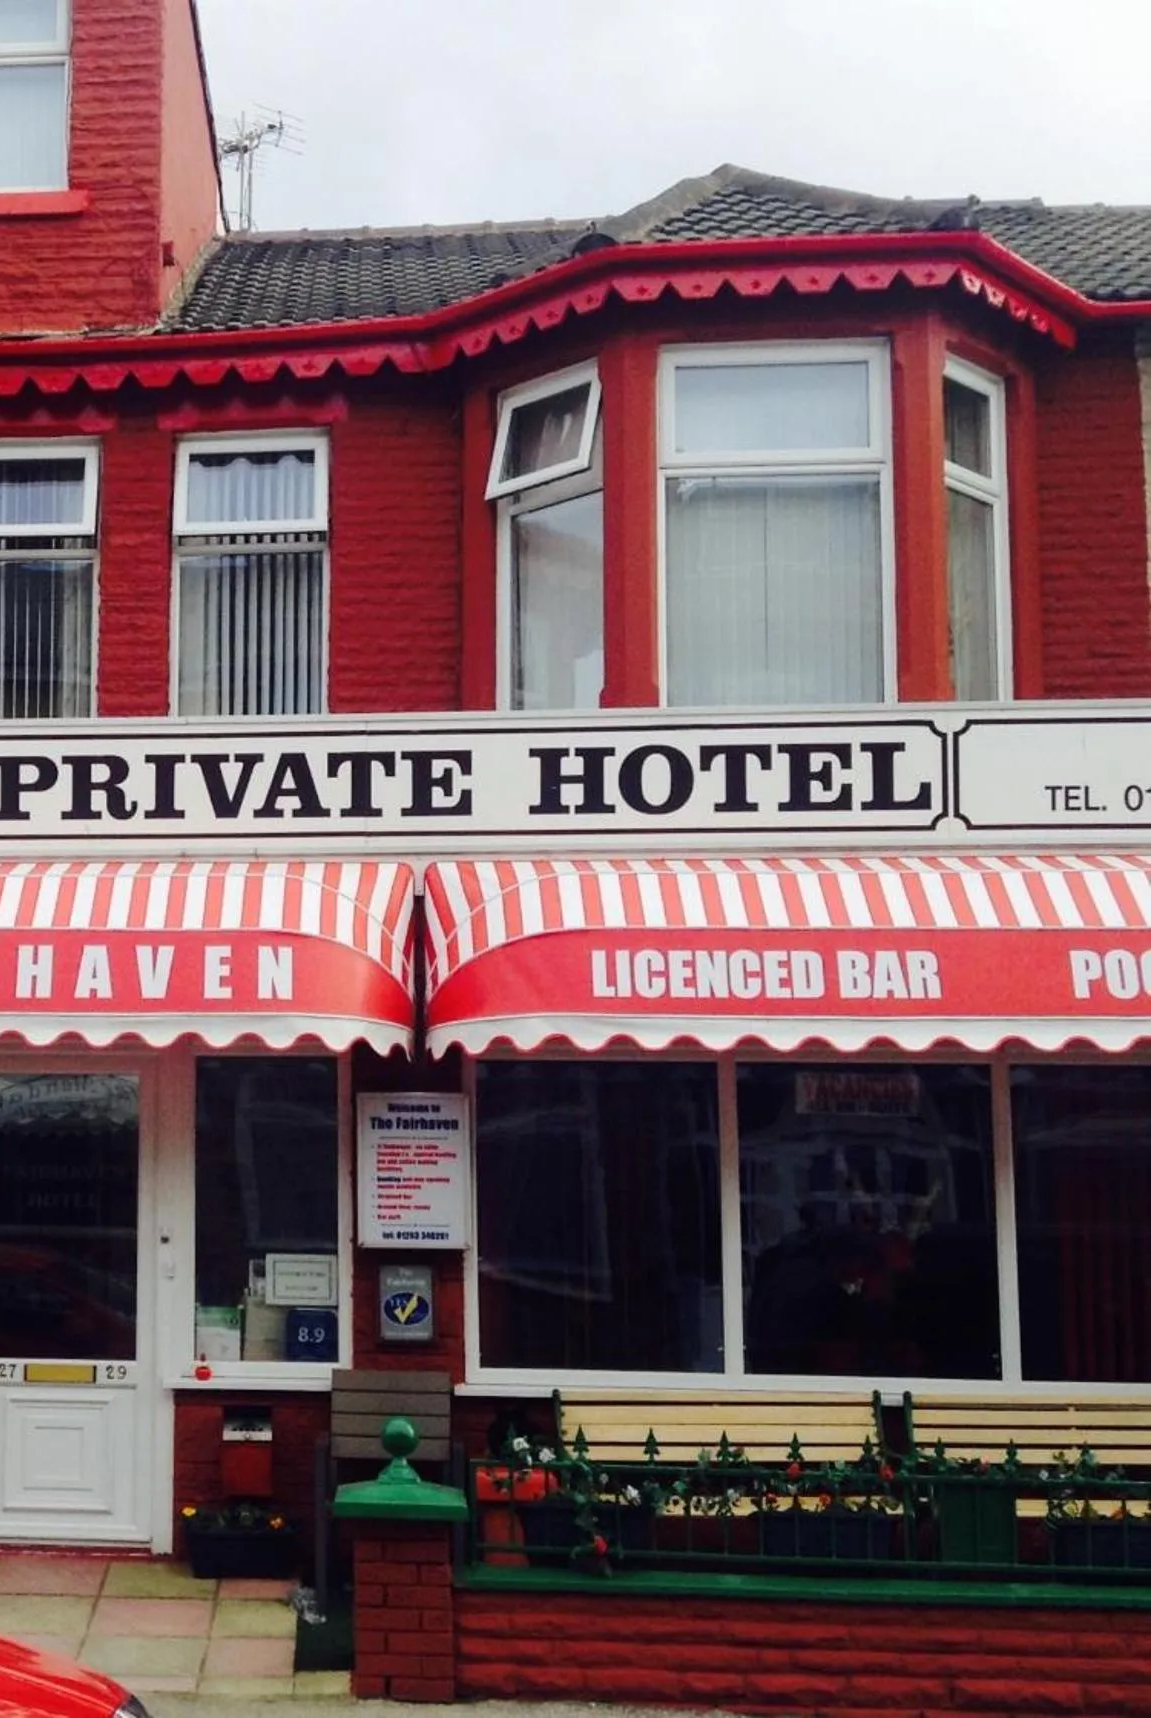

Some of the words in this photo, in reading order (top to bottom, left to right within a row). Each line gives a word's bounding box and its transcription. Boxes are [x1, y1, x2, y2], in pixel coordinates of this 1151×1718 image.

[528, 741, 932, 816] HOTEL
[1044, 785, 1107, 812] TEL.
[591, 949, 825, 999] LICENCED
[836, 950, 942, 999] BAR
[370, 1116, 393, 1130] The
[395, 1116, 459, 1130] Fairhaven
[298, 1327, 325, 1343] 8.9
[105, 1364, 127, 1380] 29
